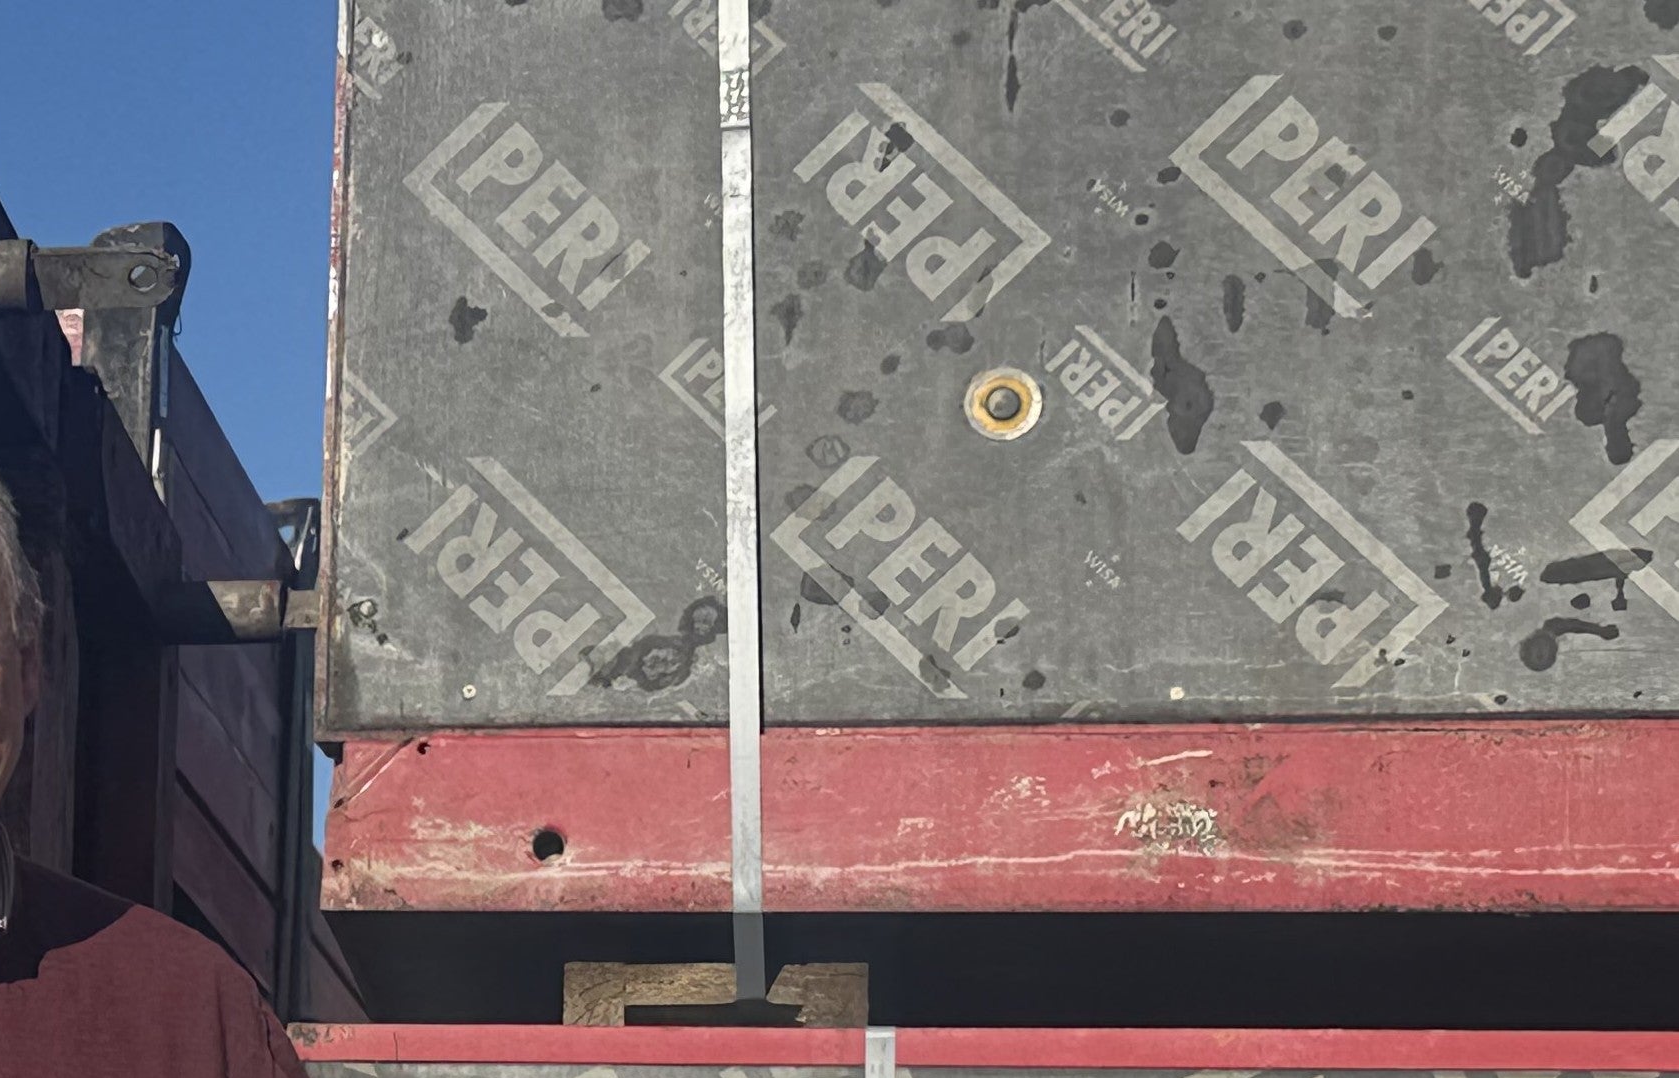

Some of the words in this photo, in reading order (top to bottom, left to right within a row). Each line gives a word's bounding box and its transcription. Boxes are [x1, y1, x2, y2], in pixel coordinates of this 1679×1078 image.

[456, 121, 651, 311] PERI
[794, 110, 997, 301] PERI
[1092, 178, 1128, 217] WISA
[1226, 95, 1436, 289] PERI
[1044, 338, 1142, 429] PERI
[1473, 327, 1579, 422] PERI
[404, 484, 600, 674] PERI
[825, 476, 1030, 671] PERI
[1176, 468, 1390, 664] PERI
[1491, 545, 1528, 585] WISA
